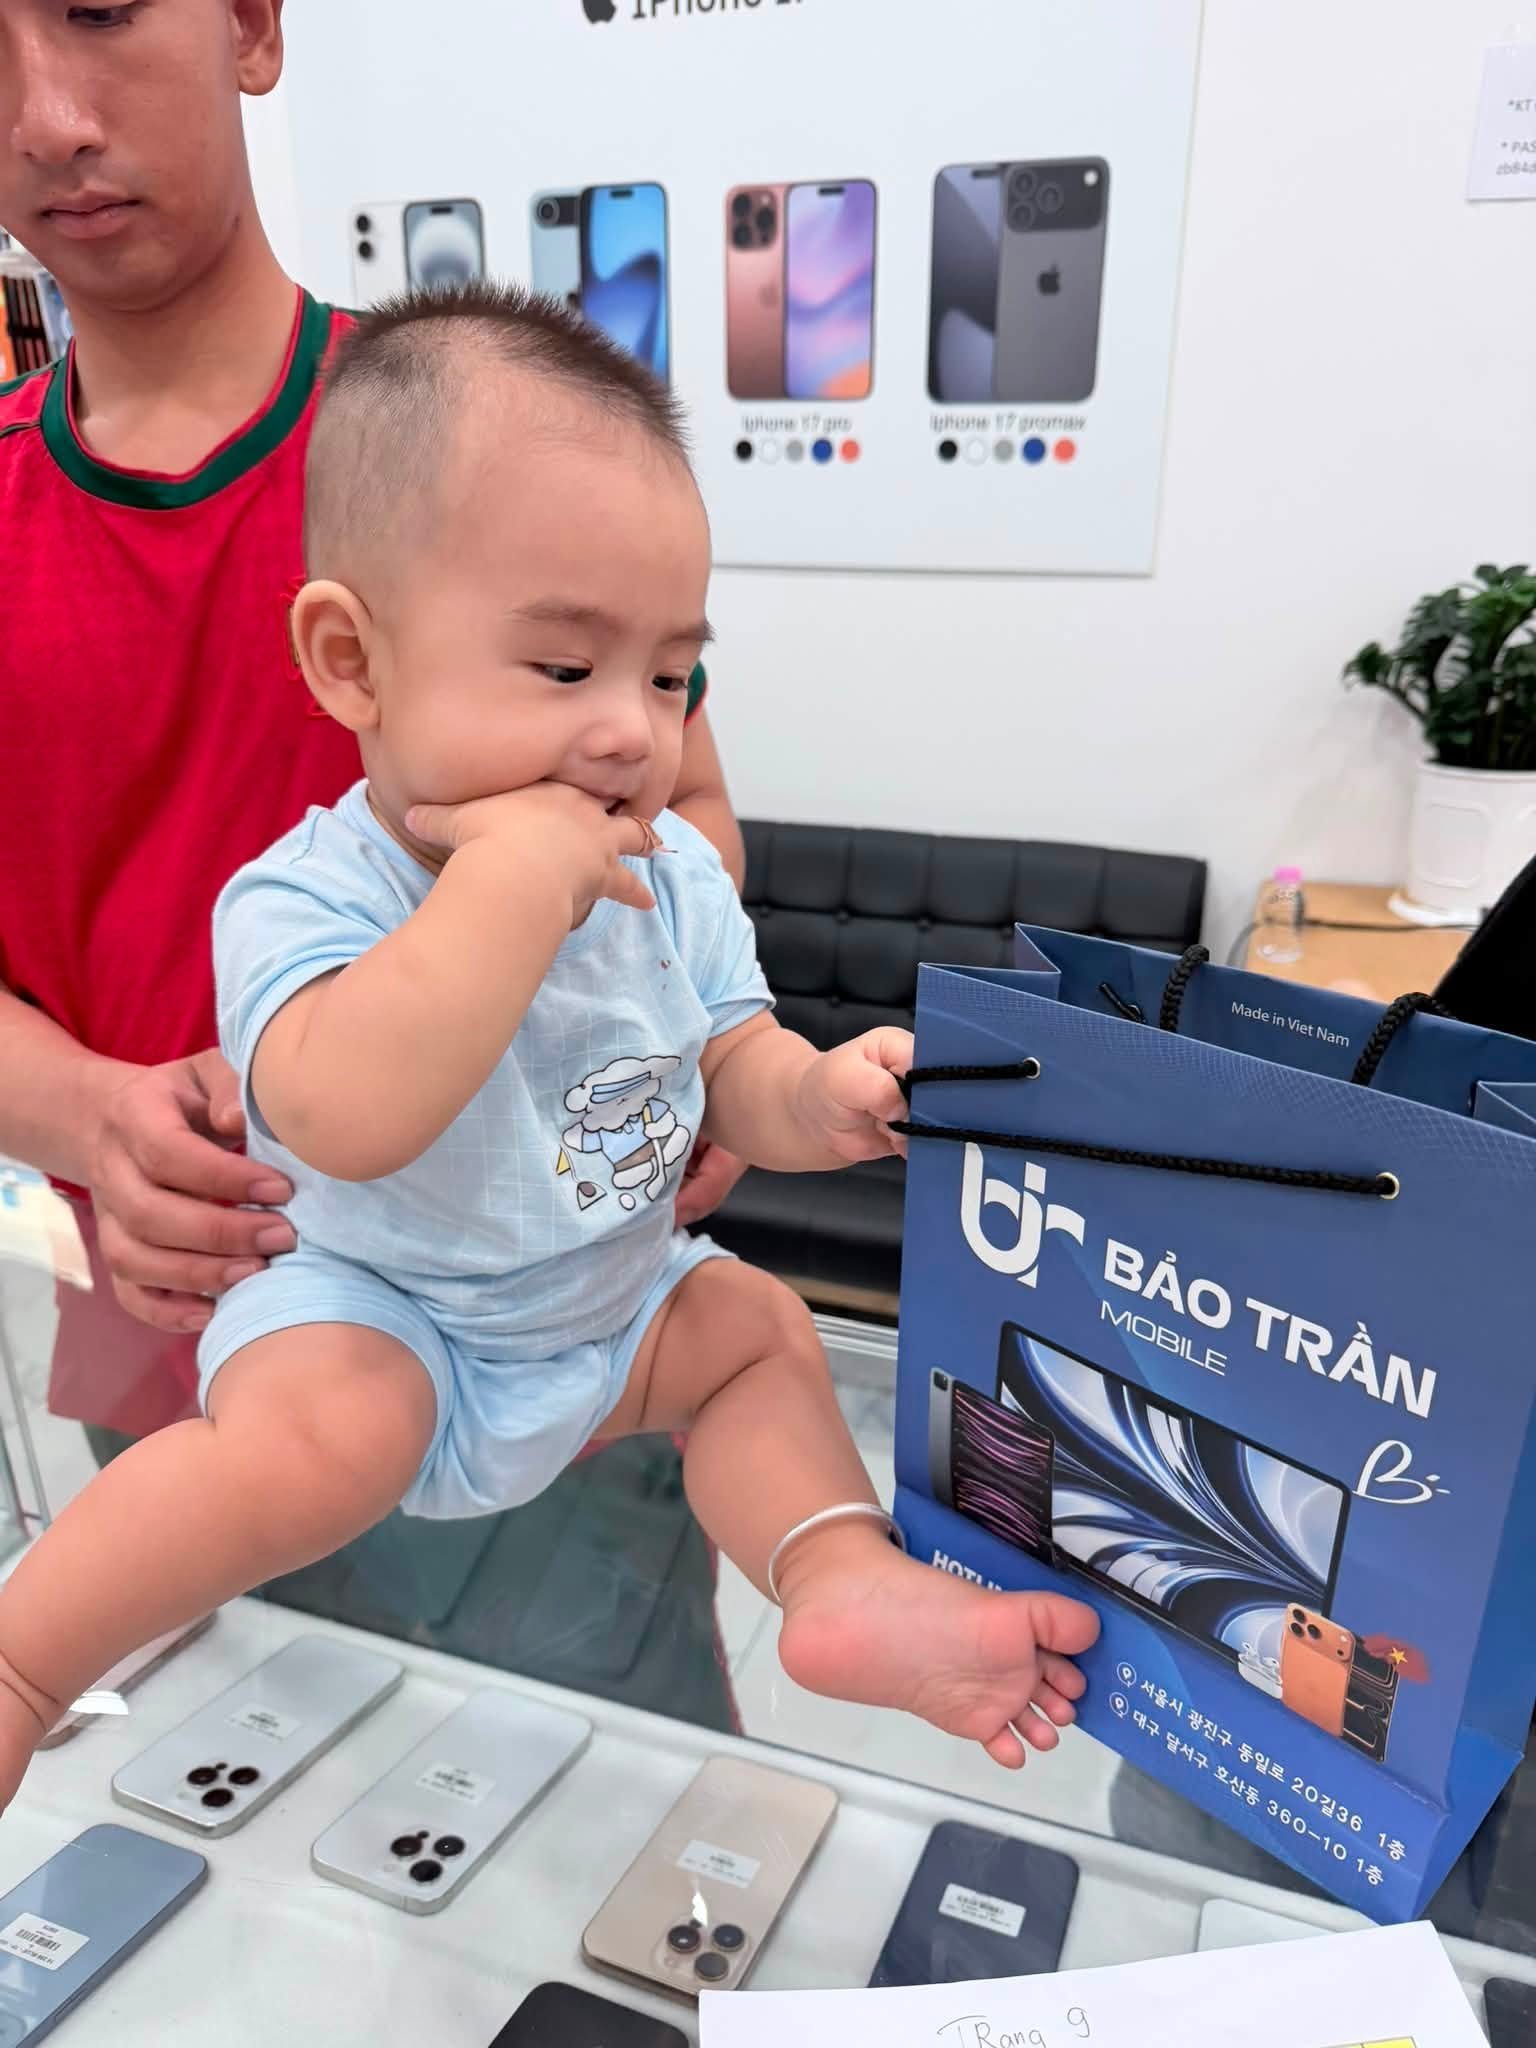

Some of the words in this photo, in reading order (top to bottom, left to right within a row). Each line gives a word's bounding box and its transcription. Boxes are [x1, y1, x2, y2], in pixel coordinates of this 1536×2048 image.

[801, 414, 821, 432] 17
[996, 414, 1017, 432] 17
[1231, 1001, 1270, 1022] Made
[1272, 1012, 1285, 1027] in
[1288, 1017, 1314, 1036] Viet
[1316, 1026, 1350, 1048] Nam
[1100, 1300, 1228, 1377] MOBILE
[1103, 1238, 1232, 1329] BẢO
[1246, 1297, 1437, 1419] TRẦN
[1133, 1710, 1159, 1736] 대구
[1166, 1732, 1208, 1768] 달서구
[1213, 1765, 1260, 1806] 호산동
[1267, 1800, 1347, 1860] 360-10
[1357, 1859, 1384, 1885] 1층
[1140, 1680, 1183, 1717] 서울시
[1188, 1709, 1232, 1746] 광진구
[1238, 1743, 1285, 1783] 동일로
[1291, 1777, 1363, 1831] 20길36
[1378, 1833, 1406, 1860] 1층
